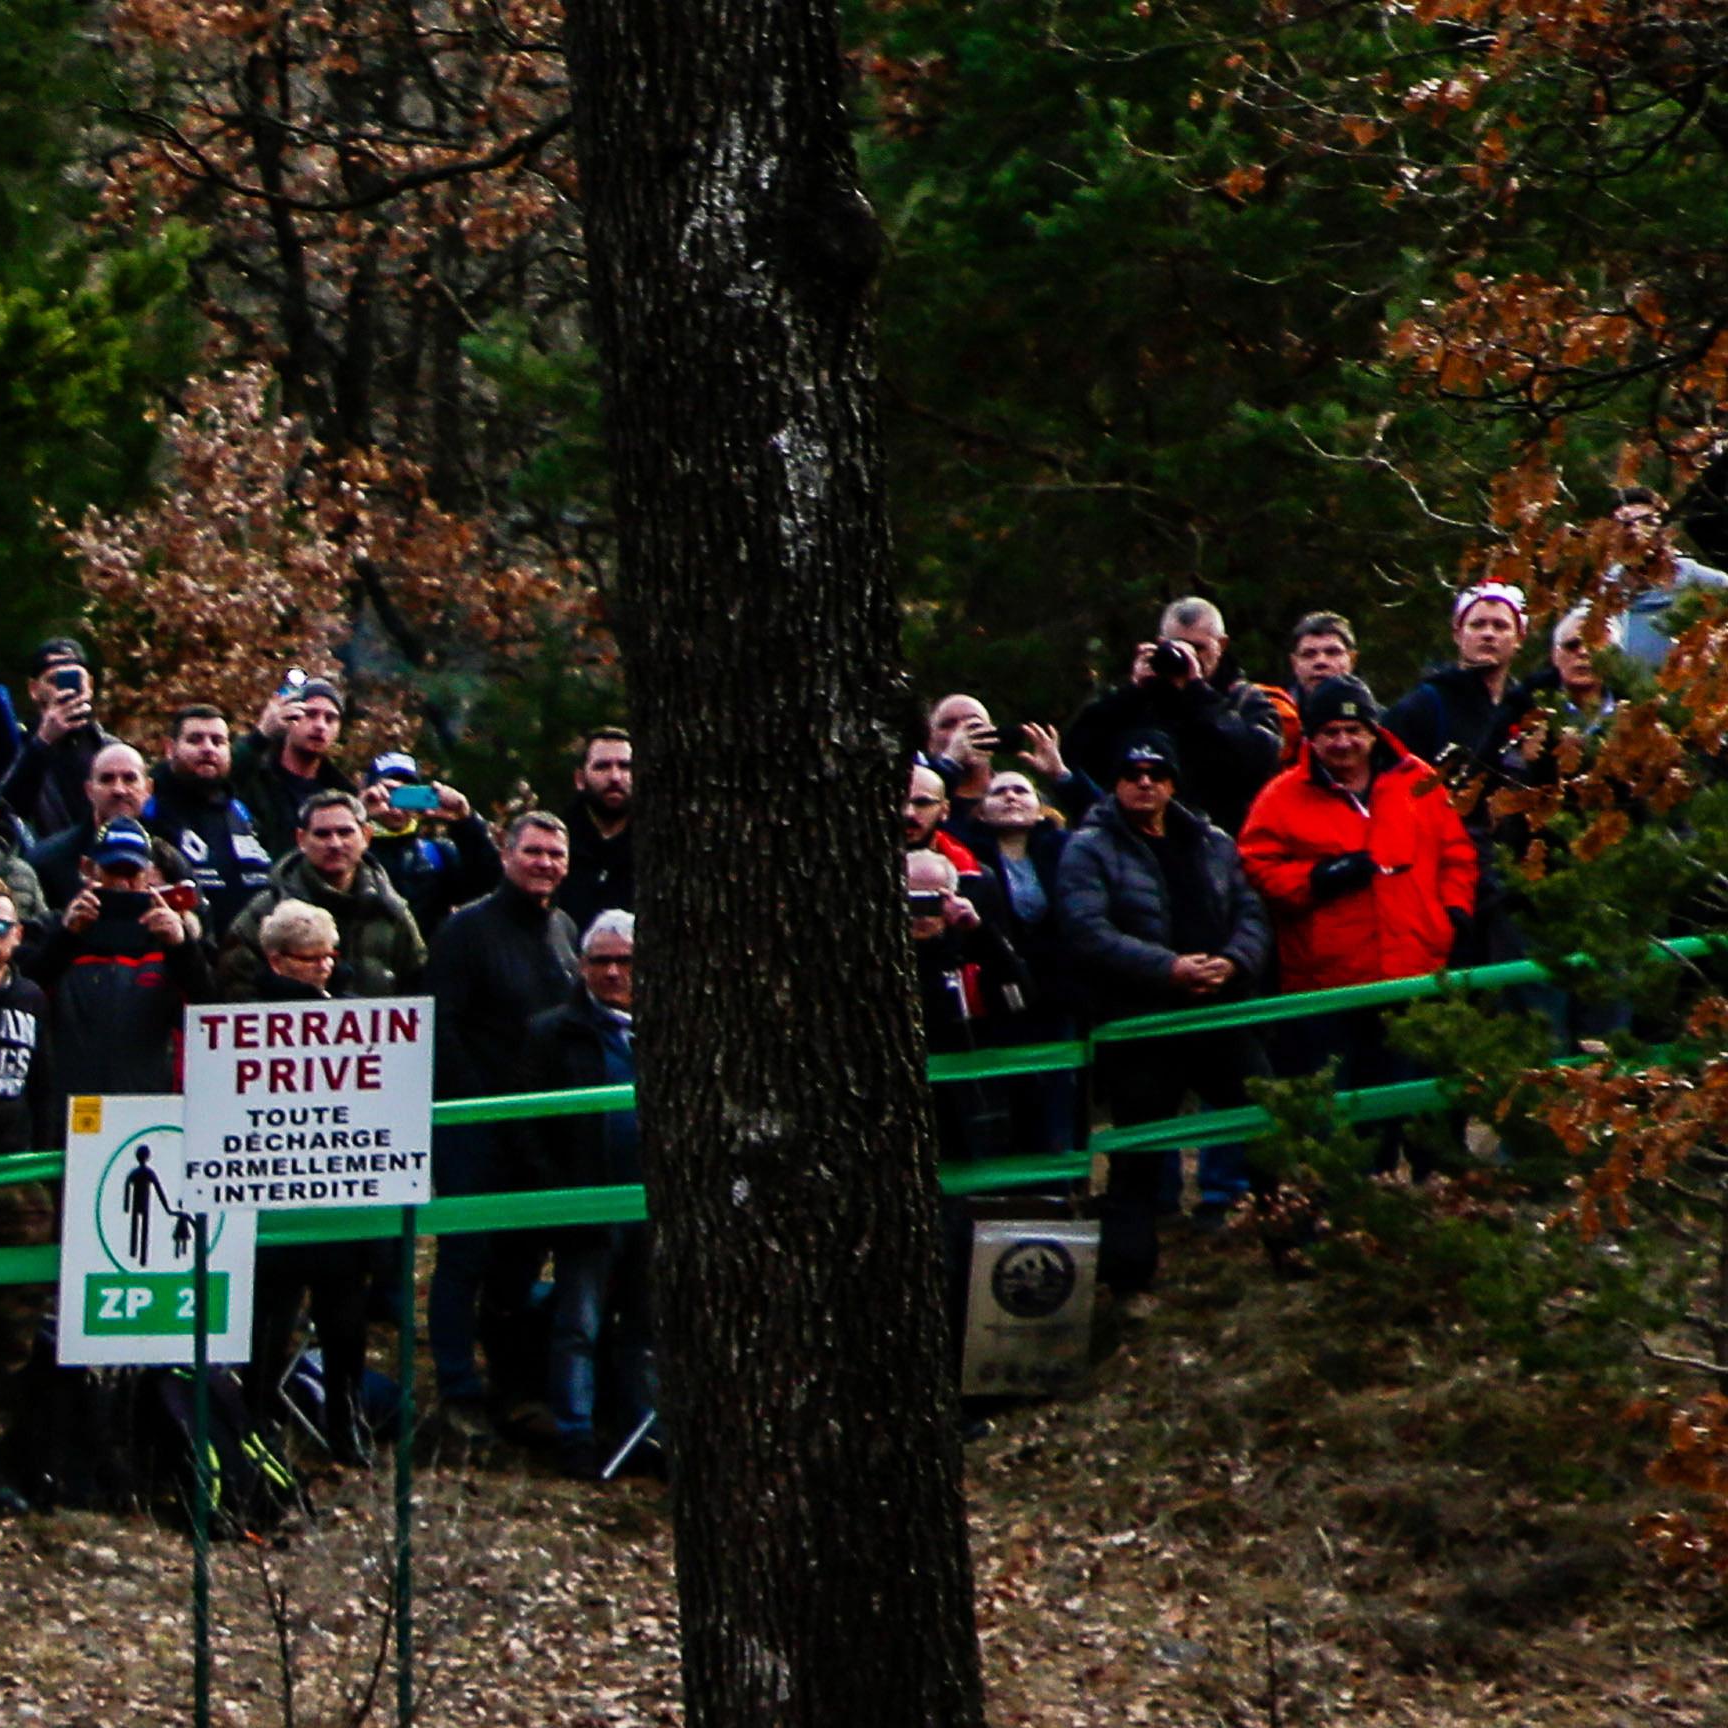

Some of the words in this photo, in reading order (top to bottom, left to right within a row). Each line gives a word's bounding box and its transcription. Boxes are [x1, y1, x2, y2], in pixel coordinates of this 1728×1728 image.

[199, 1007, 421, 1050] TERRAIN
[247, 1106, 351, 1127] TOUTE
[185, 1152, 428, 1179] FORMELLEMENT
[213, 1179, 380, 1203] INTERDITE
[98, 1287, 153, 1318] ZP
